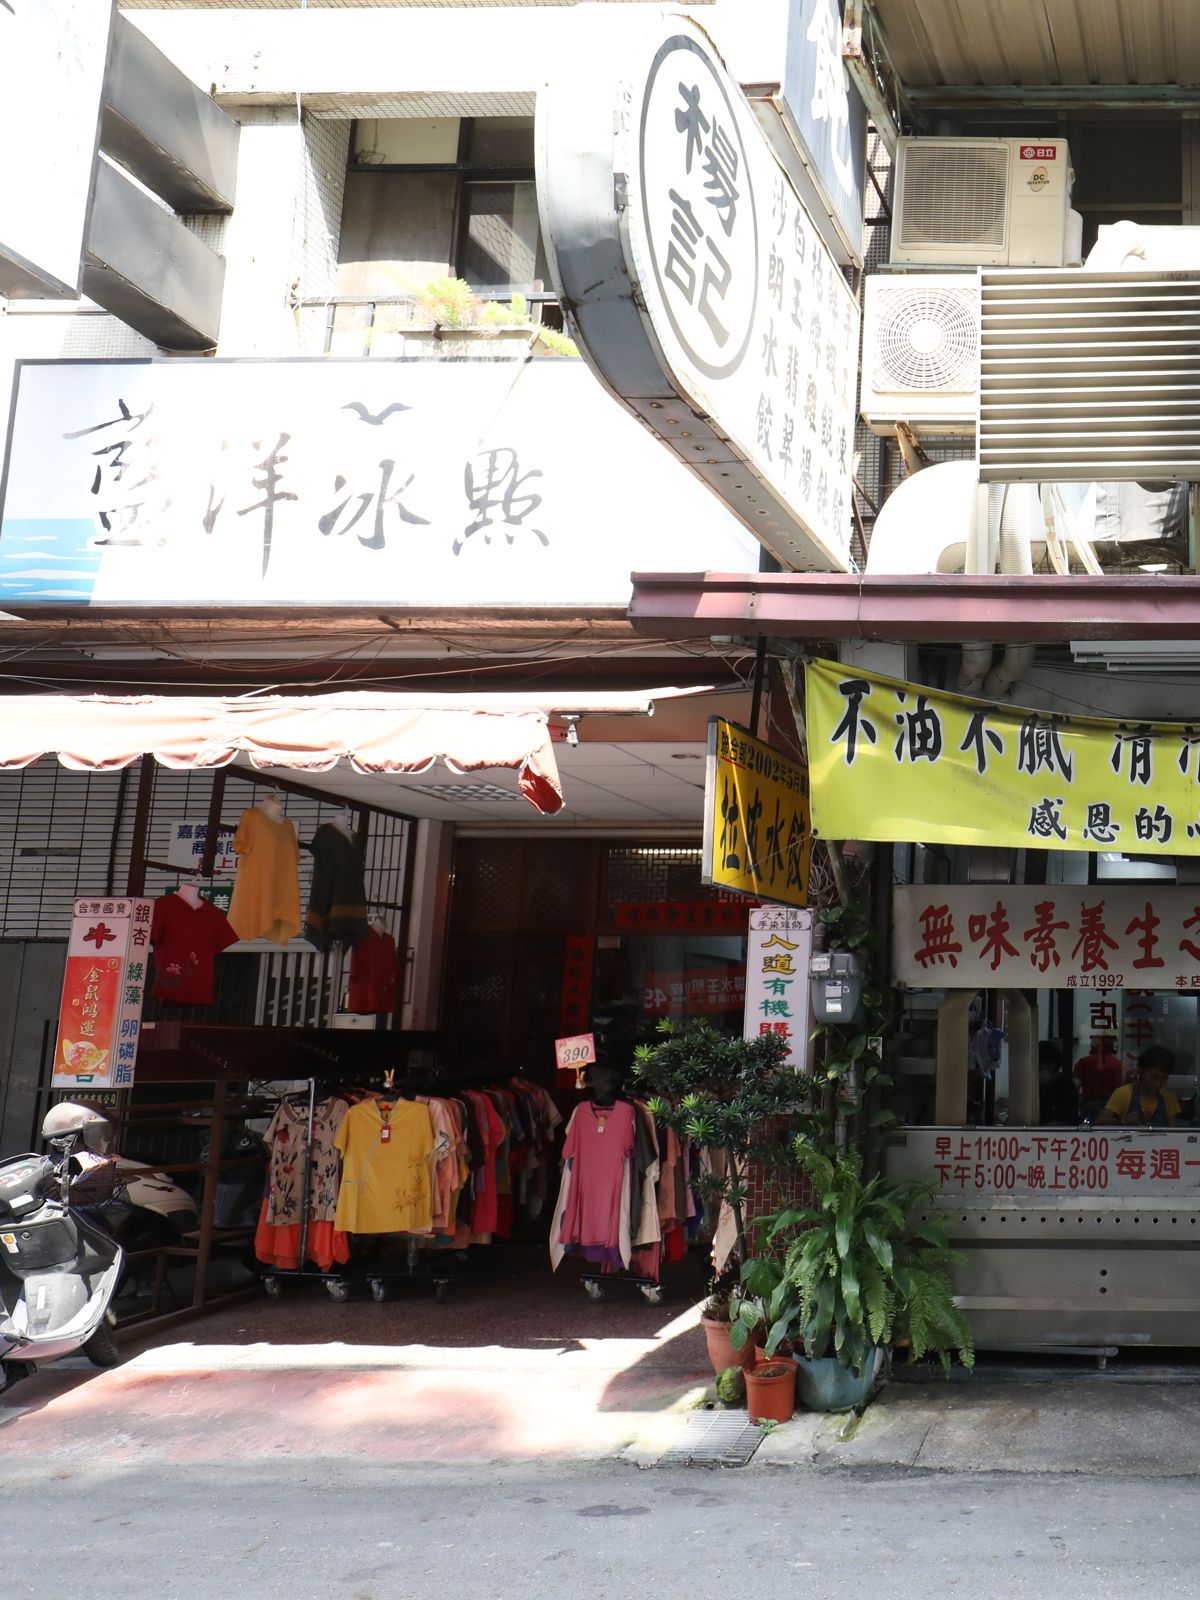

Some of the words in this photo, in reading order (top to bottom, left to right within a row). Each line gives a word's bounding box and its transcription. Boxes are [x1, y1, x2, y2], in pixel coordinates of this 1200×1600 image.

[1037, 149, 1054, 157] 日立
[831, 680, 1073, 784] 不油不膩
[78, 902, 127, 914] 台灣國寶
[132, 903, 151, 947] 銀杏
[82, 922, 117, 949] 牛
[125, 962, 144, 1006] 綠藻
[1066, 974, 1125, 988] 成立1992
[79, 965, 104, 1038] 金鼠鴻運
[115, 1018, 139, 1084] 卵磷脂
[563, 1045, 589, 1063] 390
